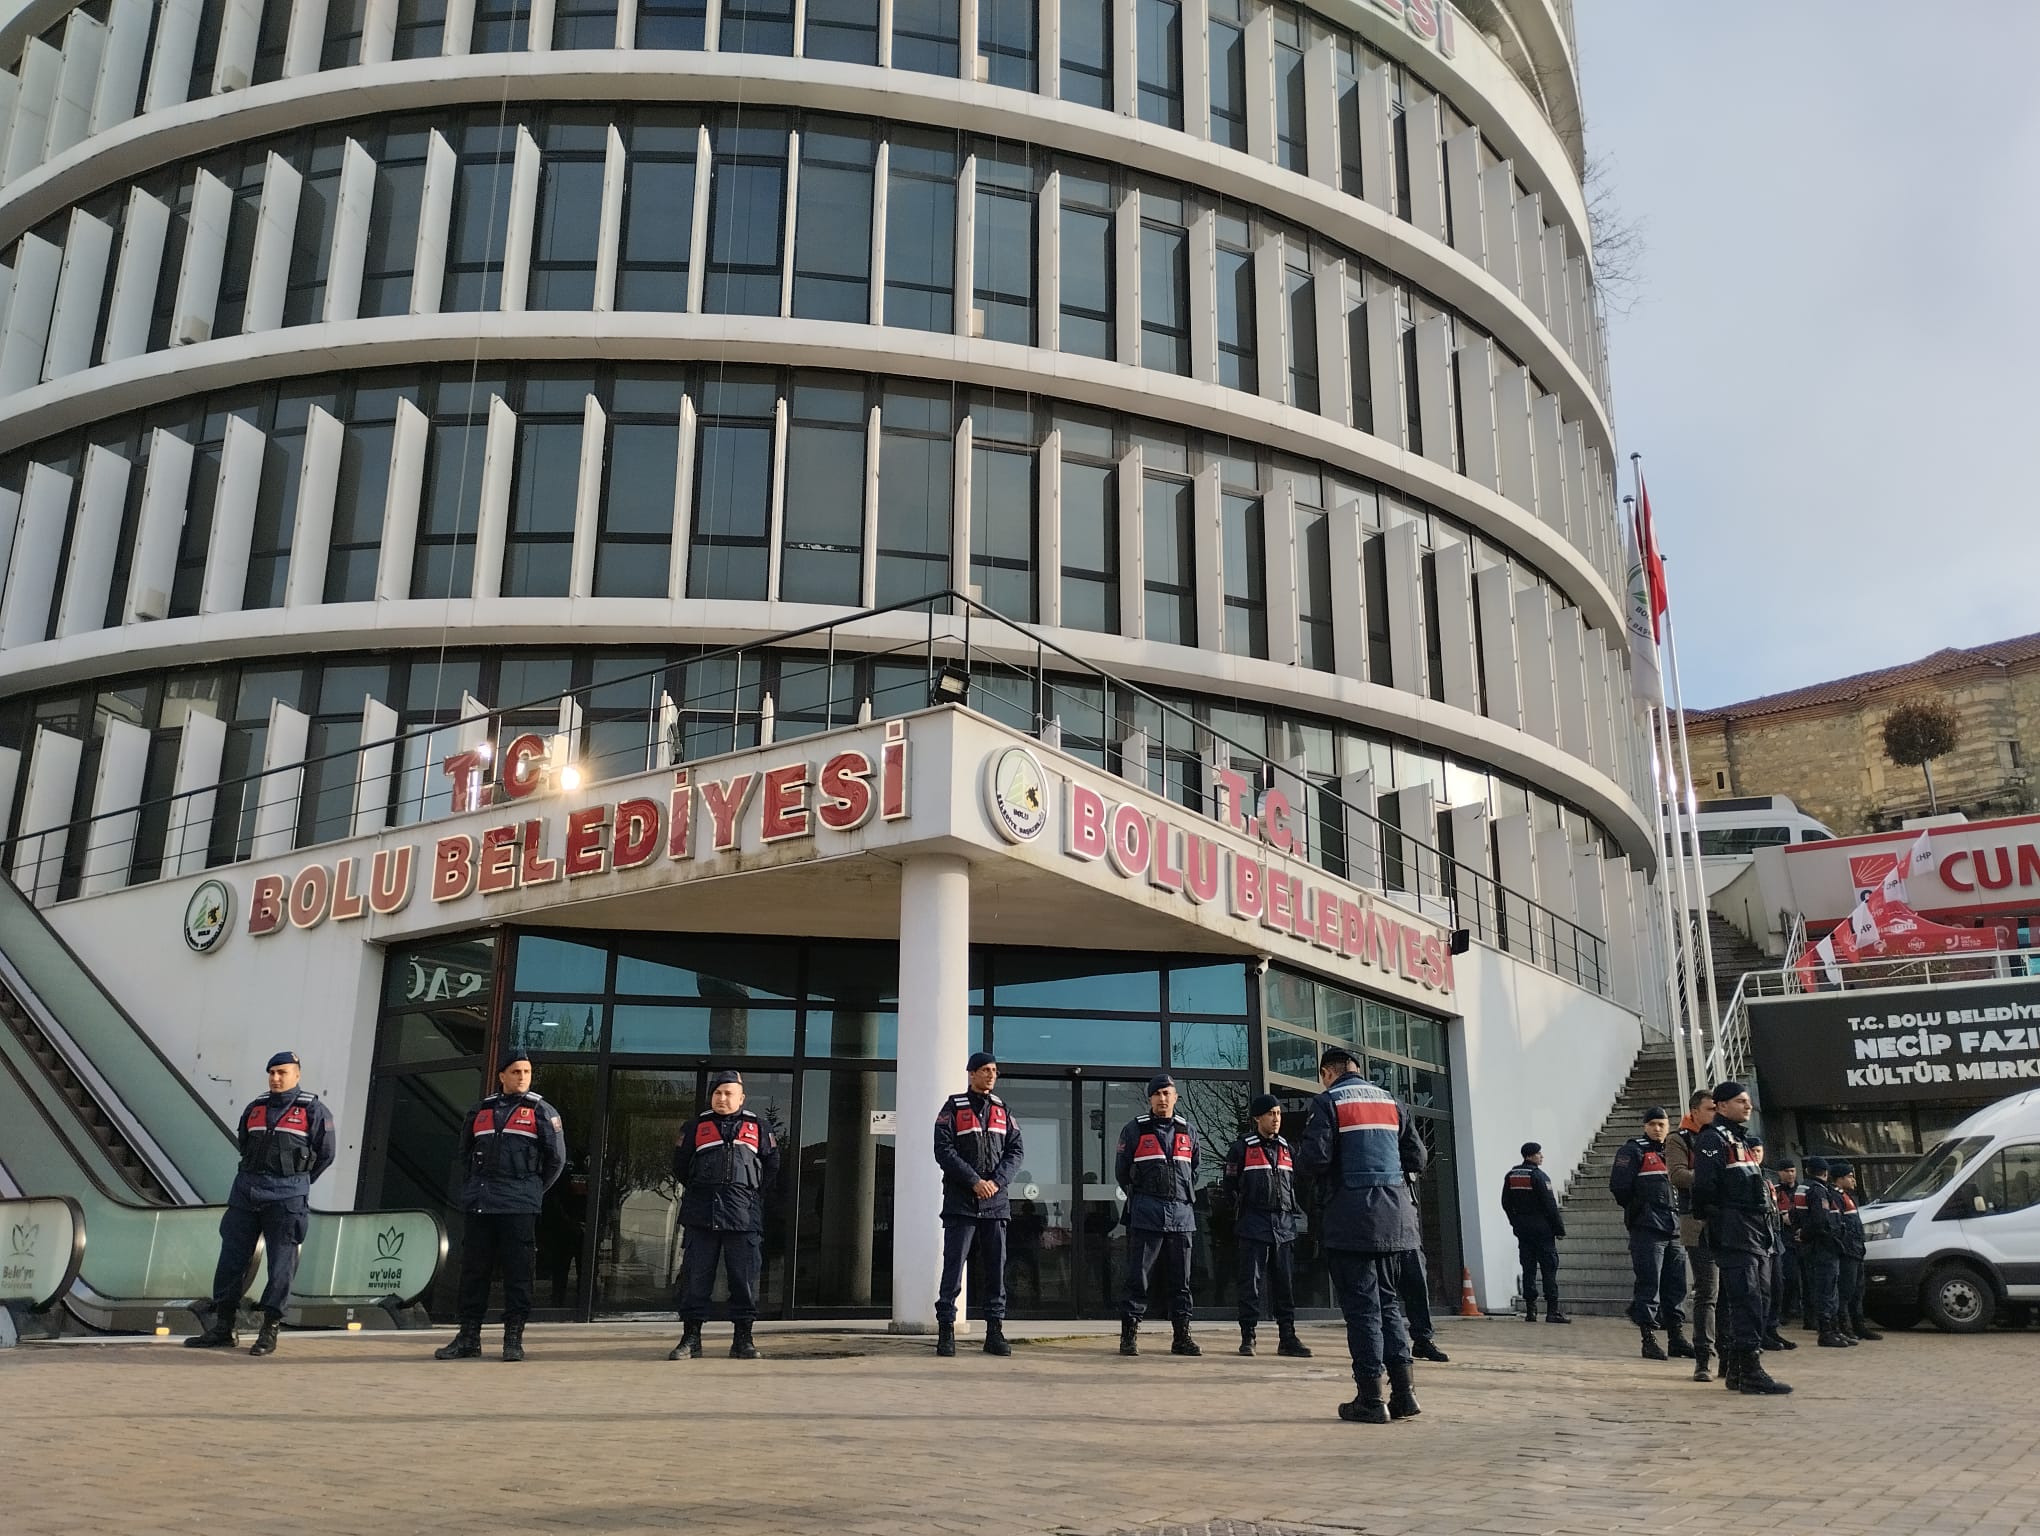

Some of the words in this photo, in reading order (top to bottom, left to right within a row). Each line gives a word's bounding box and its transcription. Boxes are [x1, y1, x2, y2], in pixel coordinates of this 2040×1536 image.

[247, 844, 421, 937] BOLU
[430, 720, 911, 904] BELEDİYESİ
[1915, 851, 1932, 863] CHP
[1064, 776, 1223, 905] BOLU
[1229, 850, 1455, 995] BELEDİYESİ
[1848, 1016, 1884, 1031] T.C.
[1887, 1011, 1942, 1029] BOLU
[1854, 1027, 1952, 1060] NECİP
[1959, 1027, 2040, 1054] FAZI
[1846, 1060, 1953, 1087] KÜLTÜR
[1956, 1058, 2040, 1081] MERK
